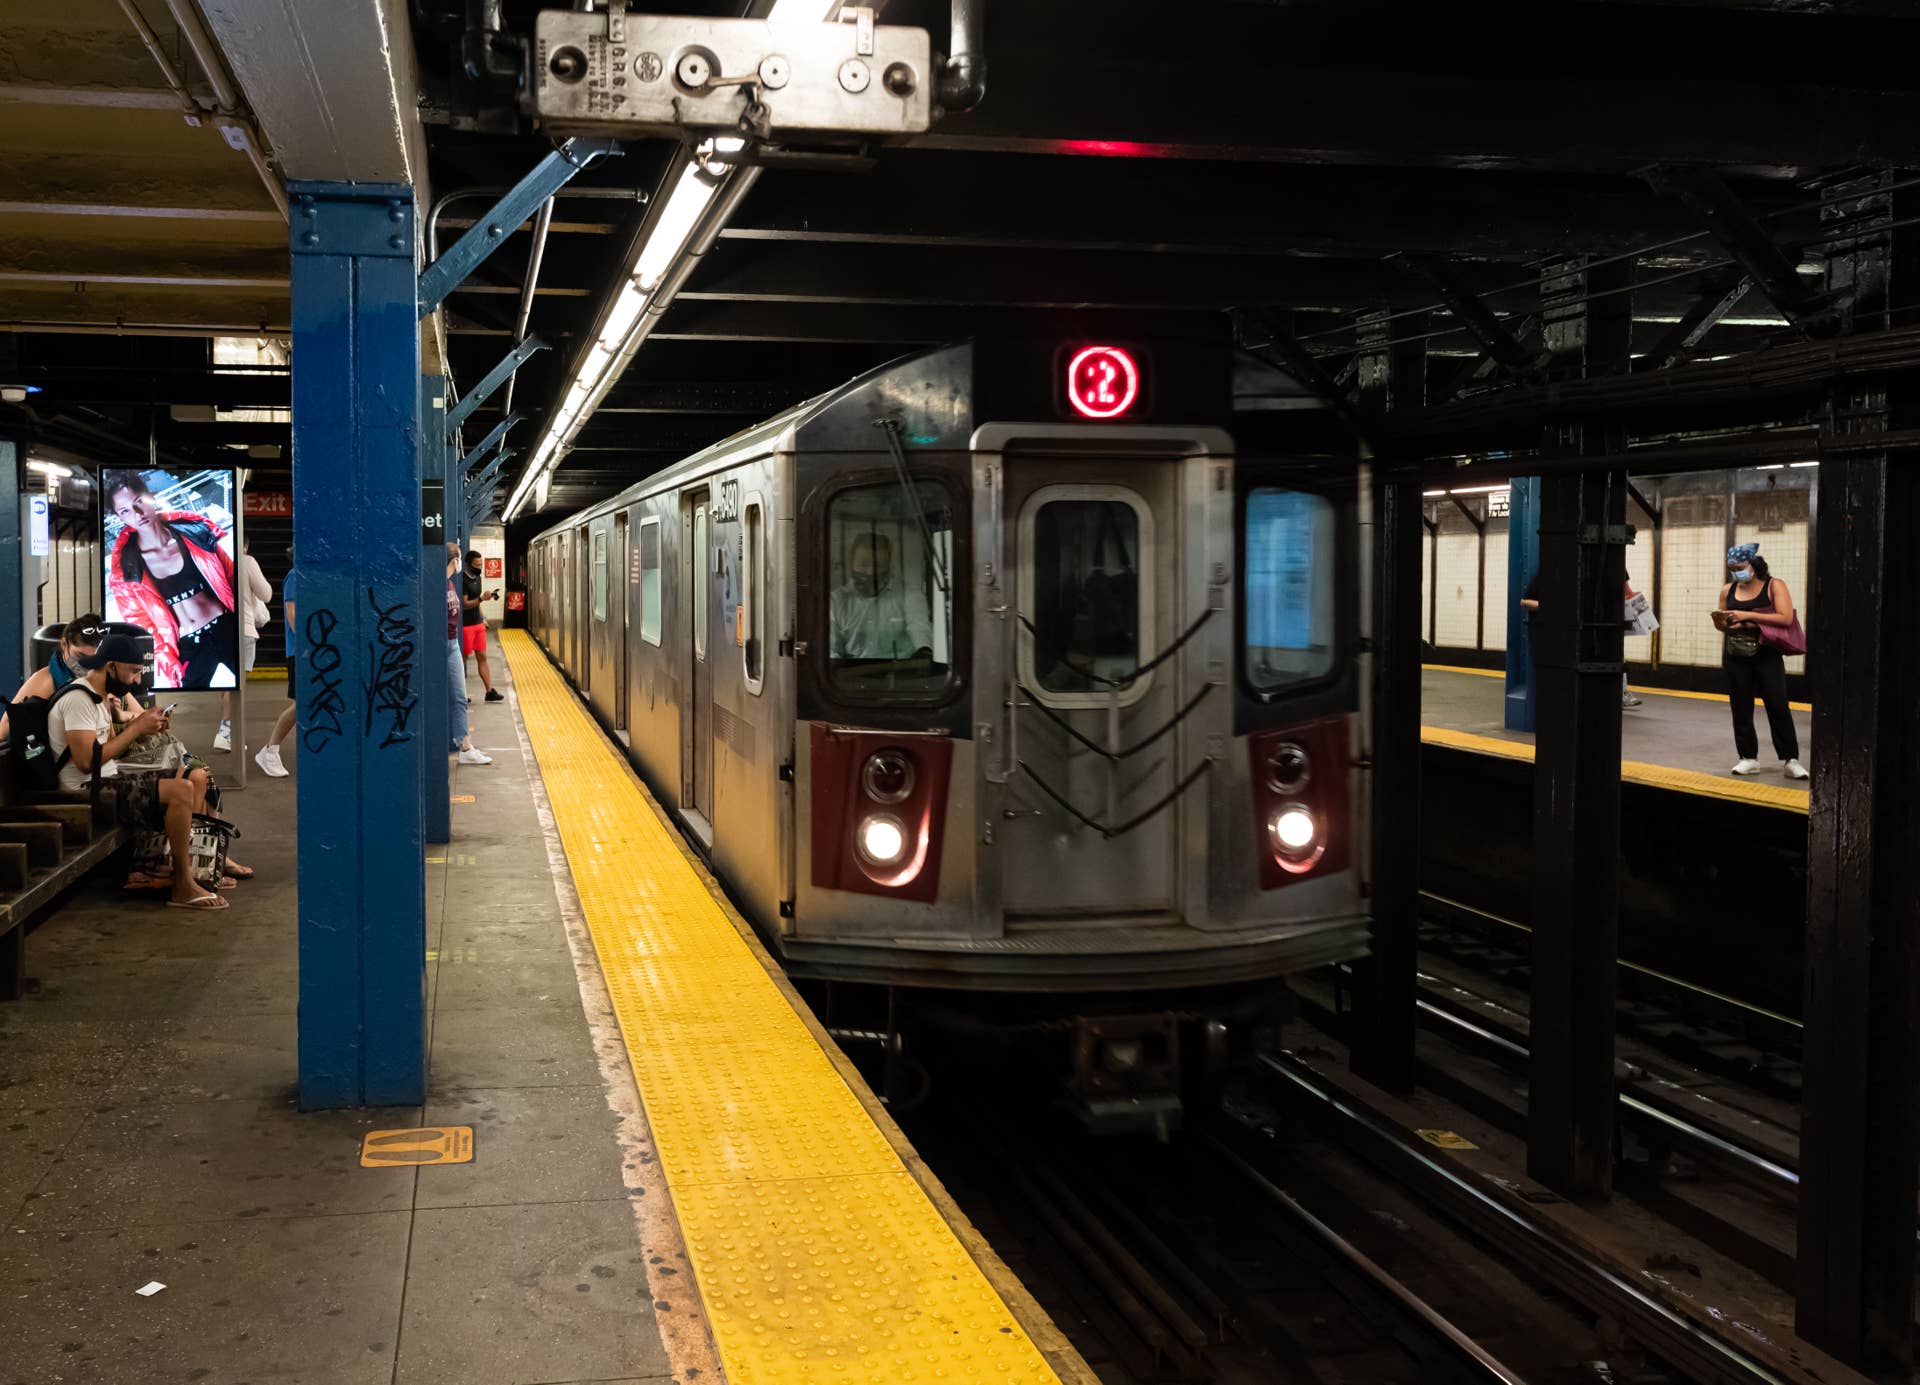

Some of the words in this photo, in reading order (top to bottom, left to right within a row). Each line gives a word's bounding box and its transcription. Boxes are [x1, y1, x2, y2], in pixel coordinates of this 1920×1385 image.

[1087, 360, 1115, 404] 2
[244, 493, 286, 512] Exit
[421, 513, 442, 527] eet
